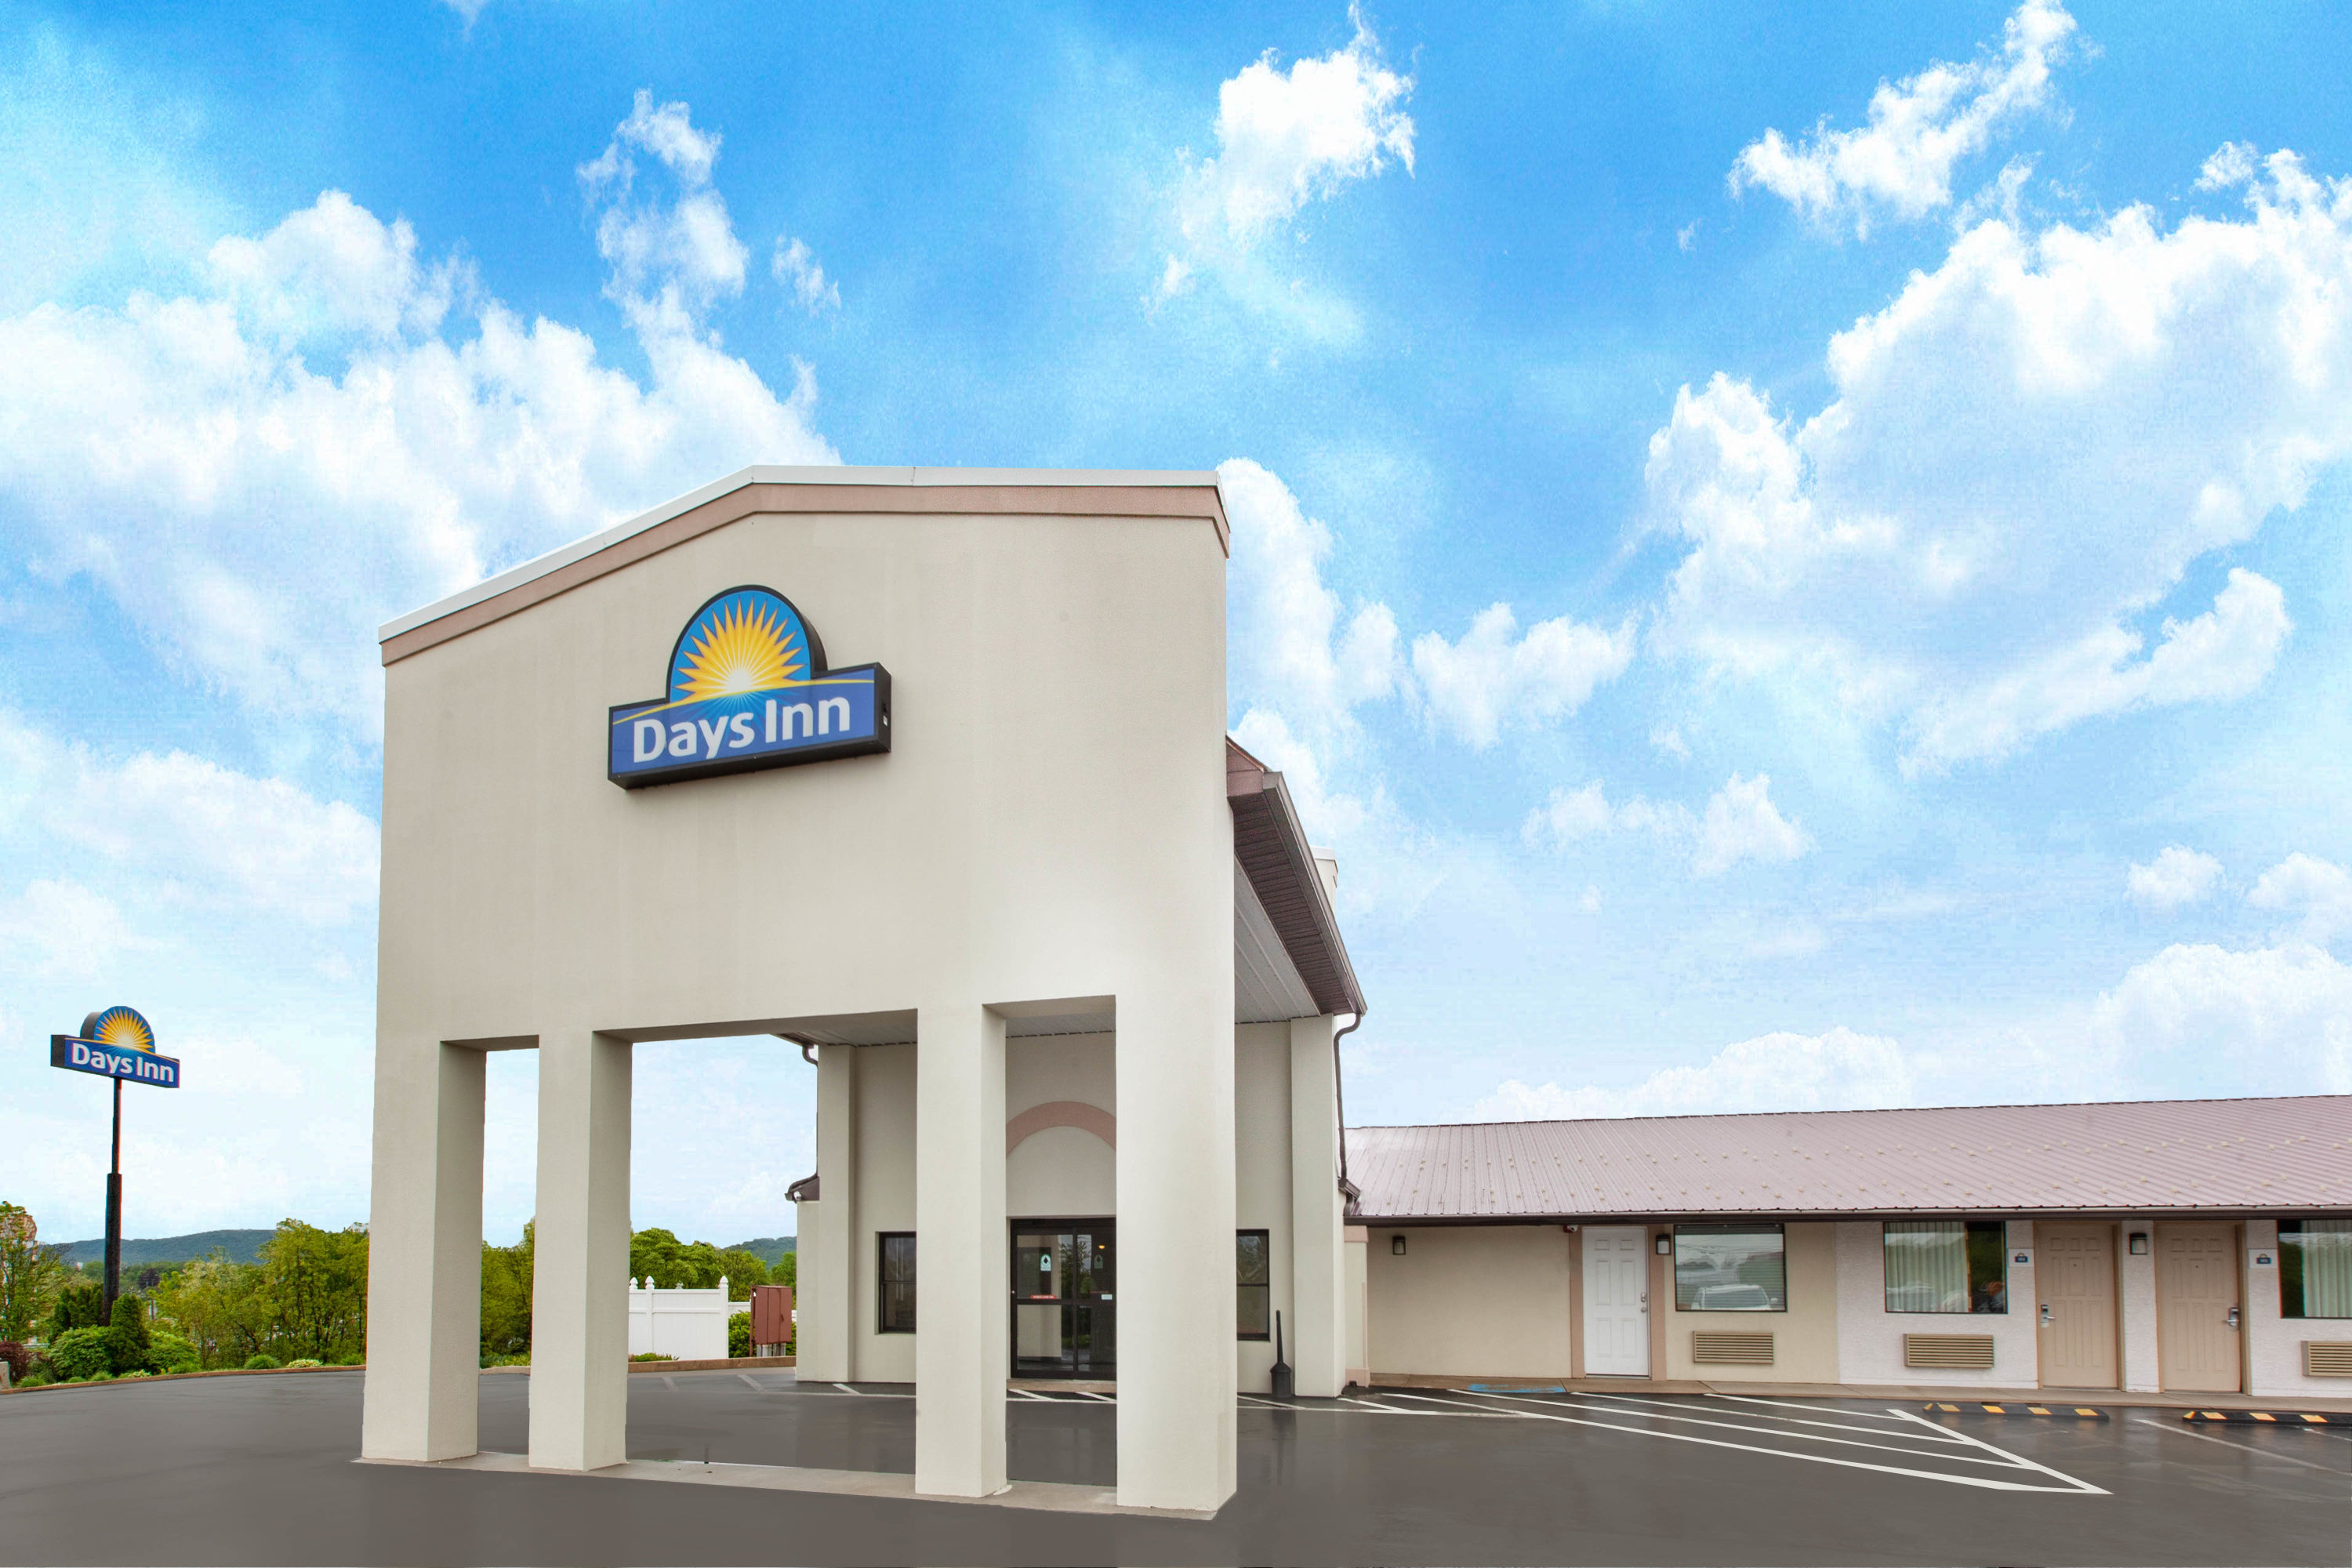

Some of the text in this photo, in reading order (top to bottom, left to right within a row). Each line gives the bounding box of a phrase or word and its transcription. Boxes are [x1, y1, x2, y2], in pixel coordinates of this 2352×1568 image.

[633, 697, 850, 763] Days Inn
[72, 1043, 174, 1082] Days Inn
